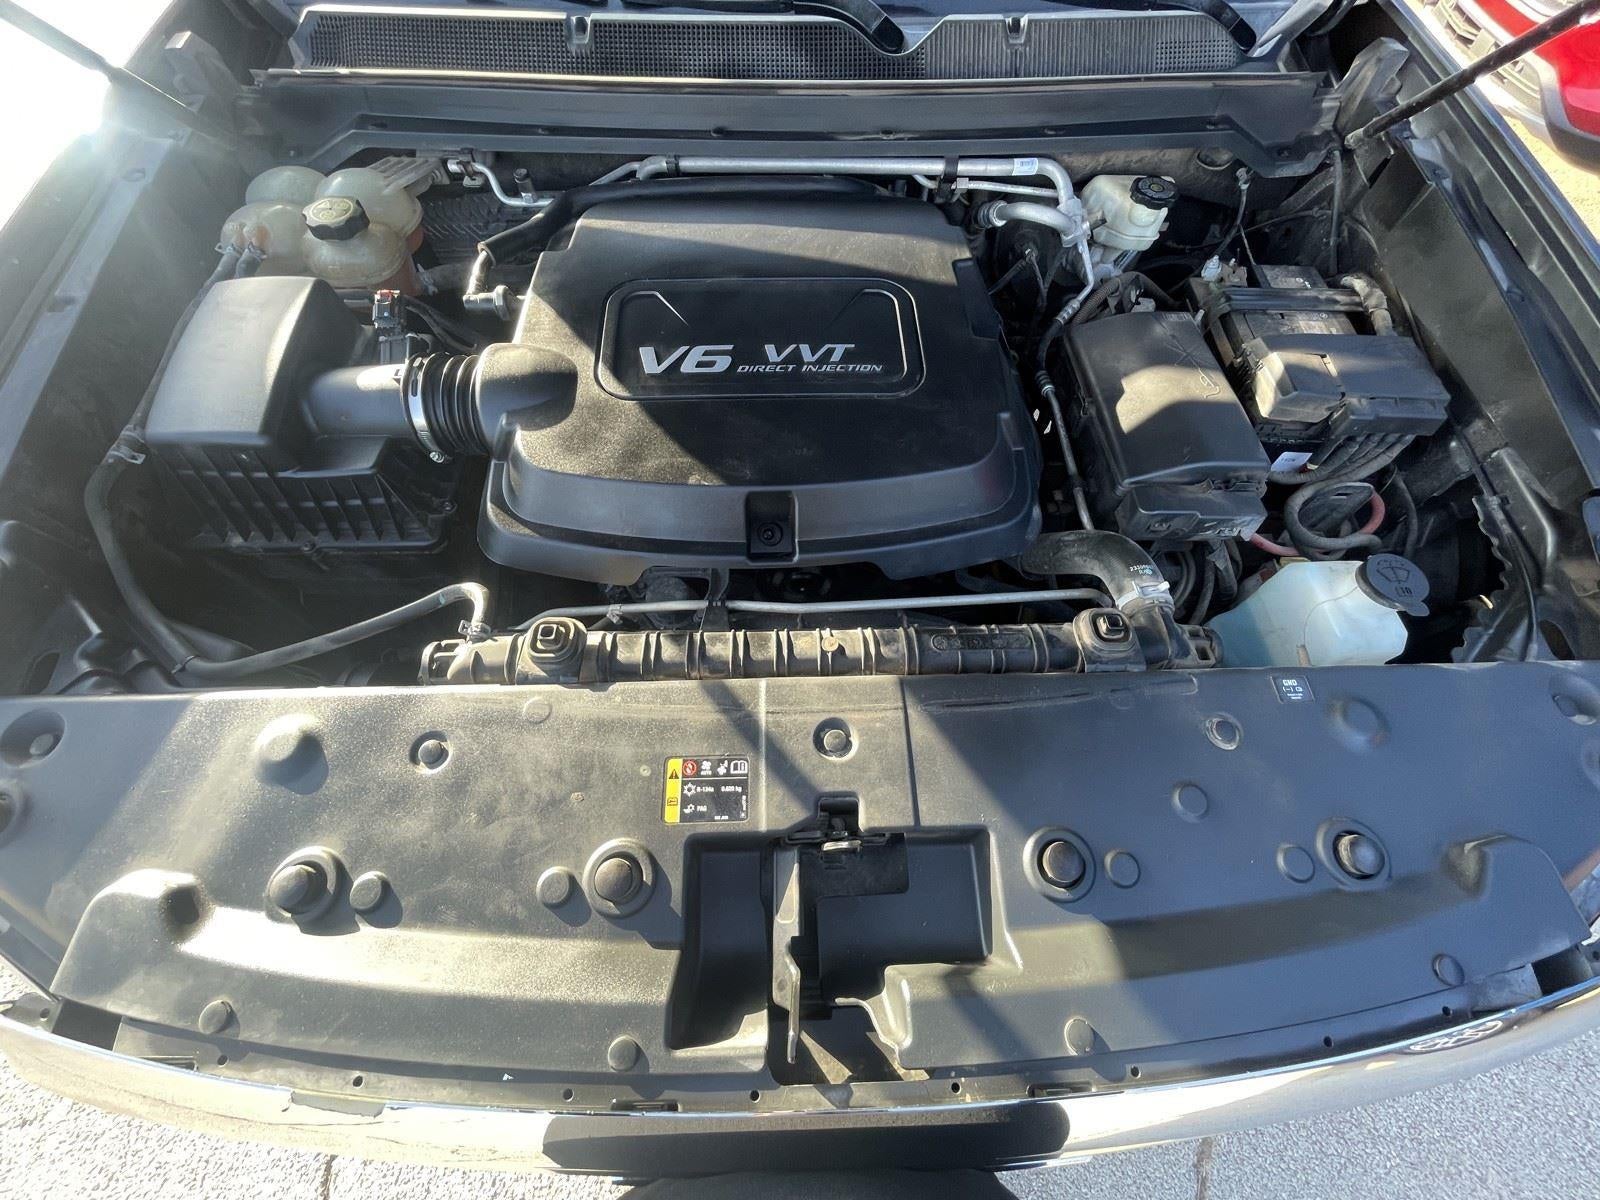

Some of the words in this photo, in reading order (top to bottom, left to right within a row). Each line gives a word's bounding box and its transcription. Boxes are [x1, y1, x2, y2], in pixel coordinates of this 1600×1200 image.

[639, 344, 734, 374] V6
[764, 344, 855, 362] VVT
[737, 364, 796, 373] DIRECT
[801, 364, 883, 373] INJECTION
